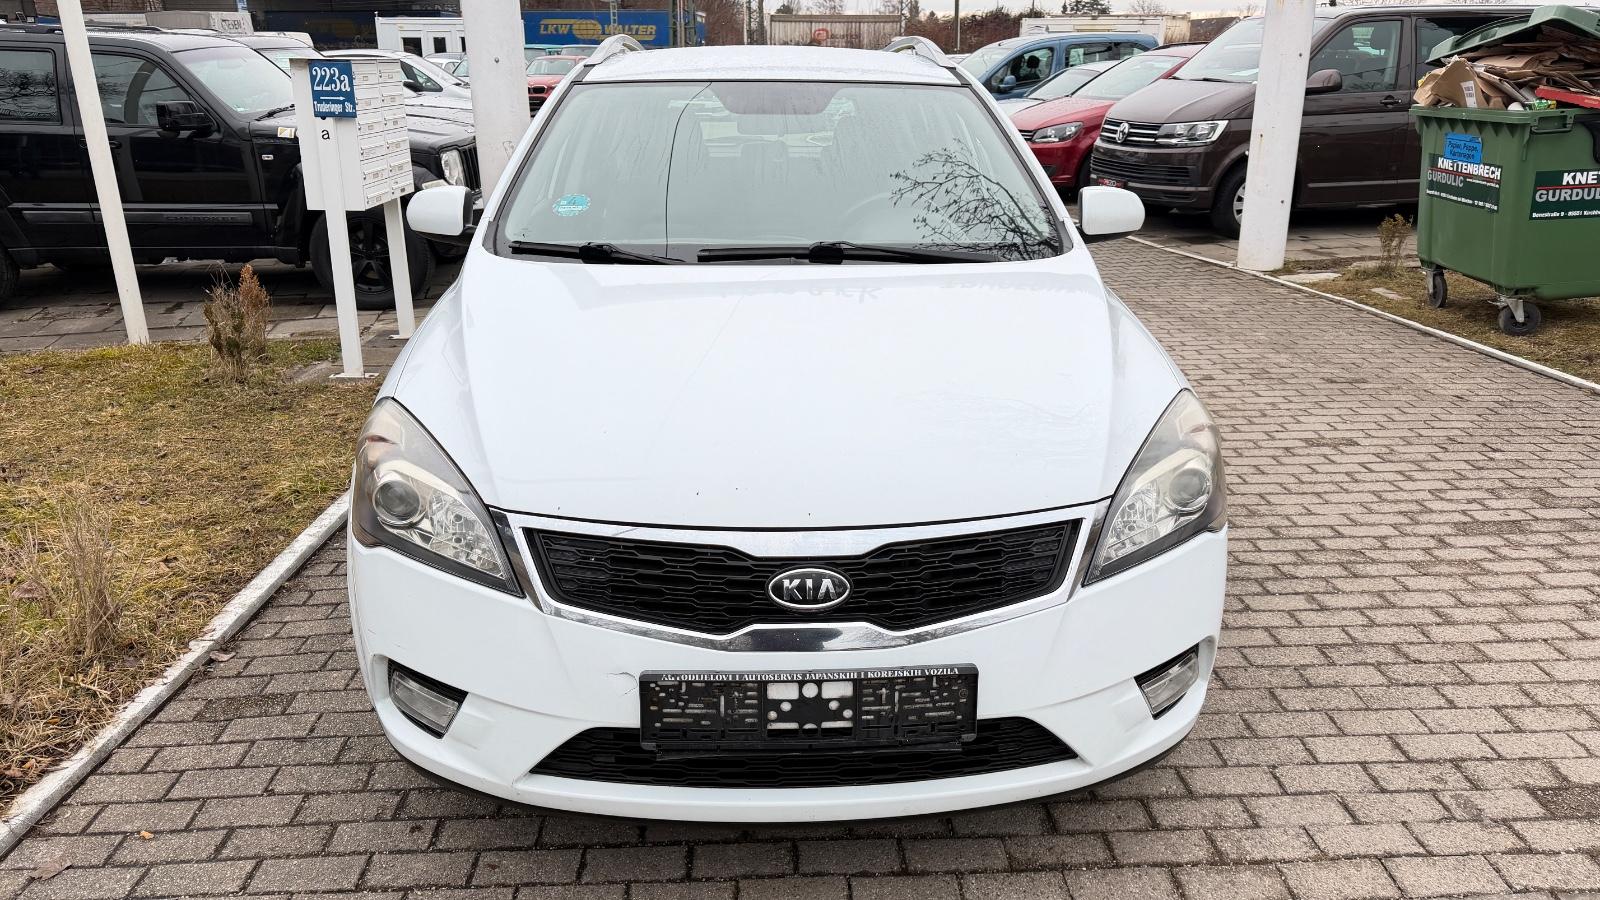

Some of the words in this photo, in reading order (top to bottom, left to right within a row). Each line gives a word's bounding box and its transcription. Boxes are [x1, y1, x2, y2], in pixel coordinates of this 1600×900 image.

[540, 24, 571, 34] LKW
[604, 24, 657, 35] WALTER
[312, 67, 351, 92] 223a
[313, 101, 343, 115] Truderinger
[344, 102, 356, 113] Str.
[321, 129, 331, 140] a
[1437, 157, 1501, 180] KNETTENBRECH
[1427, 169, 1464, 188] GURDULIC
[782, 578, 838, 600] KIA
[742, 673, 803, 681] AUTOSERVIS
[804, 672, 858, 680] JAPANSKIH
[867, 669, 922, 679] KOREJSKIH
[924, 668, 959, 676] VOZILA
